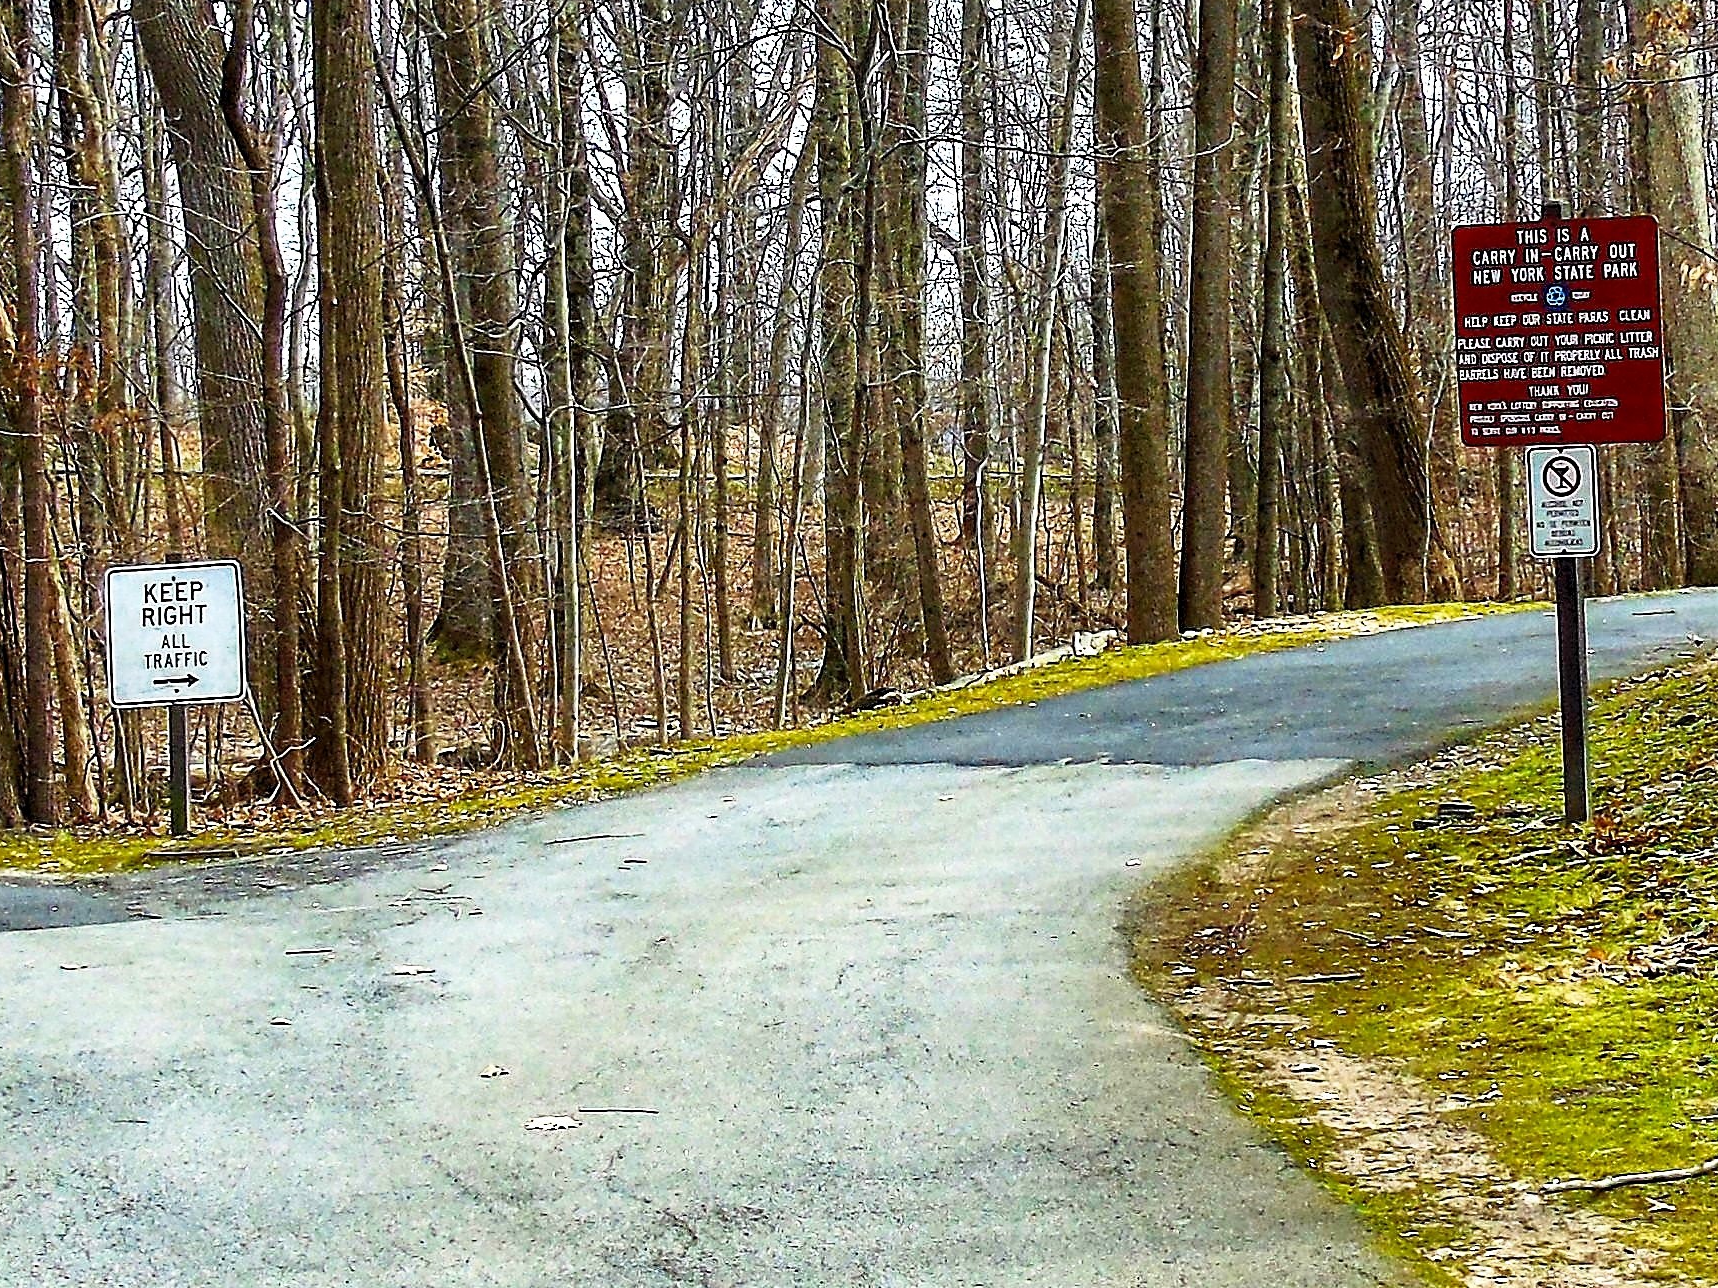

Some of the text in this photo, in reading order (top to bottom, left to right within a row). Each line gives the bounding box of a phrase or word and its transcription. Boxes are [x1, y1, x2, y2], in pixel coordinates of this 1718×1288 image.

[1517, 228, 1589, 244] THIS IS A
[1473, 249, 1515, 266] CARRY
[1610, 244, 1635, 258] OUT
[1474, 262, 1637, 284] NEW YORK STATE PARK
[1523, 314, 1540, 325] OUR
[1546, 313, 1573, 324] STATE
[1619, 310, 1650, 321] CLEAN
[1458, 338, 1491, 350] PLEASE
[1496, 337, 1524, 347] CARRY
[1531, 336, 1548, 346] OUT
[1555, 335, 1578, 345] YOUR
[1620, 331, 1652, 343] LITTER
[1482, 352, 1518, 364] DISPOSE
[1524, 352, 1536, 362] OF
[1541, 352, 1549, 362] IT
[1605, 349, 1623, 360] ALL
[1629, 347, 1658, 358] TRASH
[1504, 368, 1527, 379] HAVE
[1531, 366, 1555, 378] BEEN
[144, 581, 203, 603] KEEP
[142, 605, 207, 627] RIGHT
[161, 634, 190, 649] ALL
[144, 651, 208, 669] TRAFFIC
